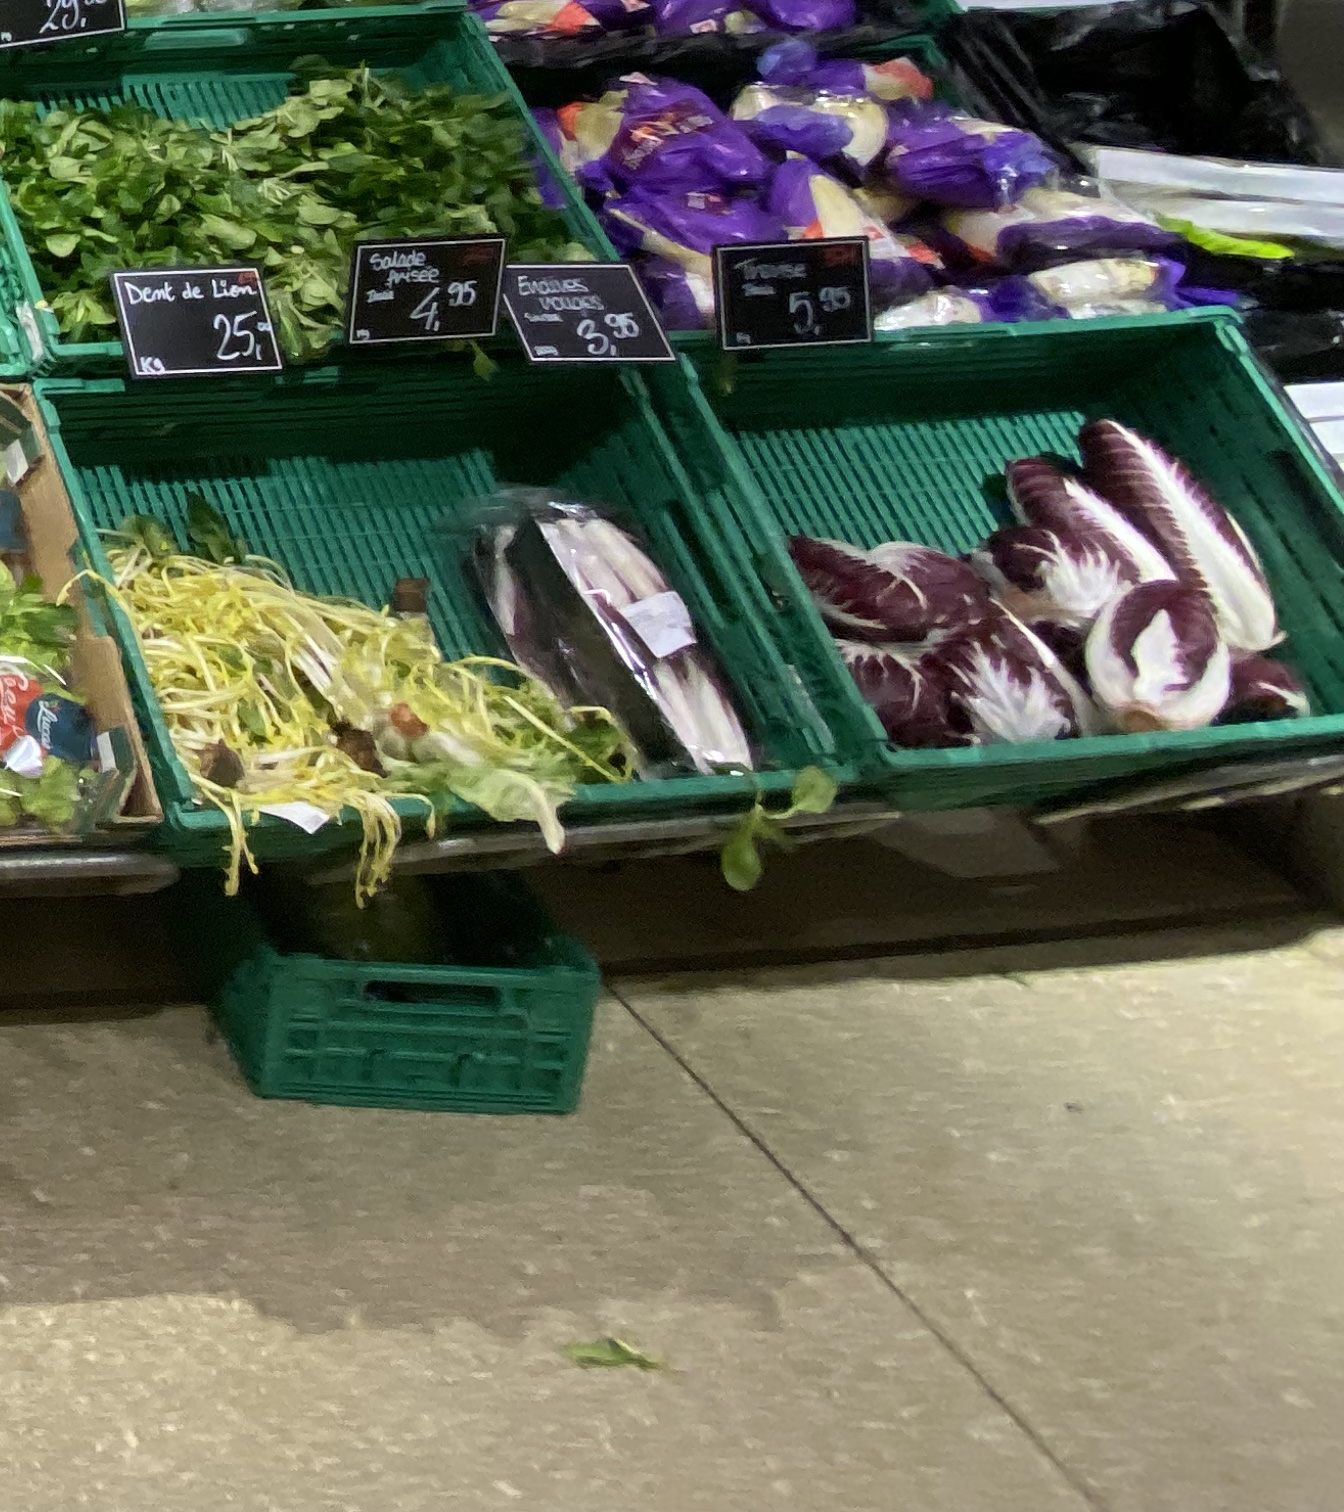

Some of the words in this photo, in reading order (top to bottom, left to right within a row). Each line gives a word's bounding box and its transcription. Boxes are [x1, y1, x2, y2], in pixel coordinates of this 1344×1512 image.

[369, 249, 427, 271] Salade
[123, 281, 176, 305] Dent
[181, 282, 205, 299] de
[211, 279, 257, 299] Lion
